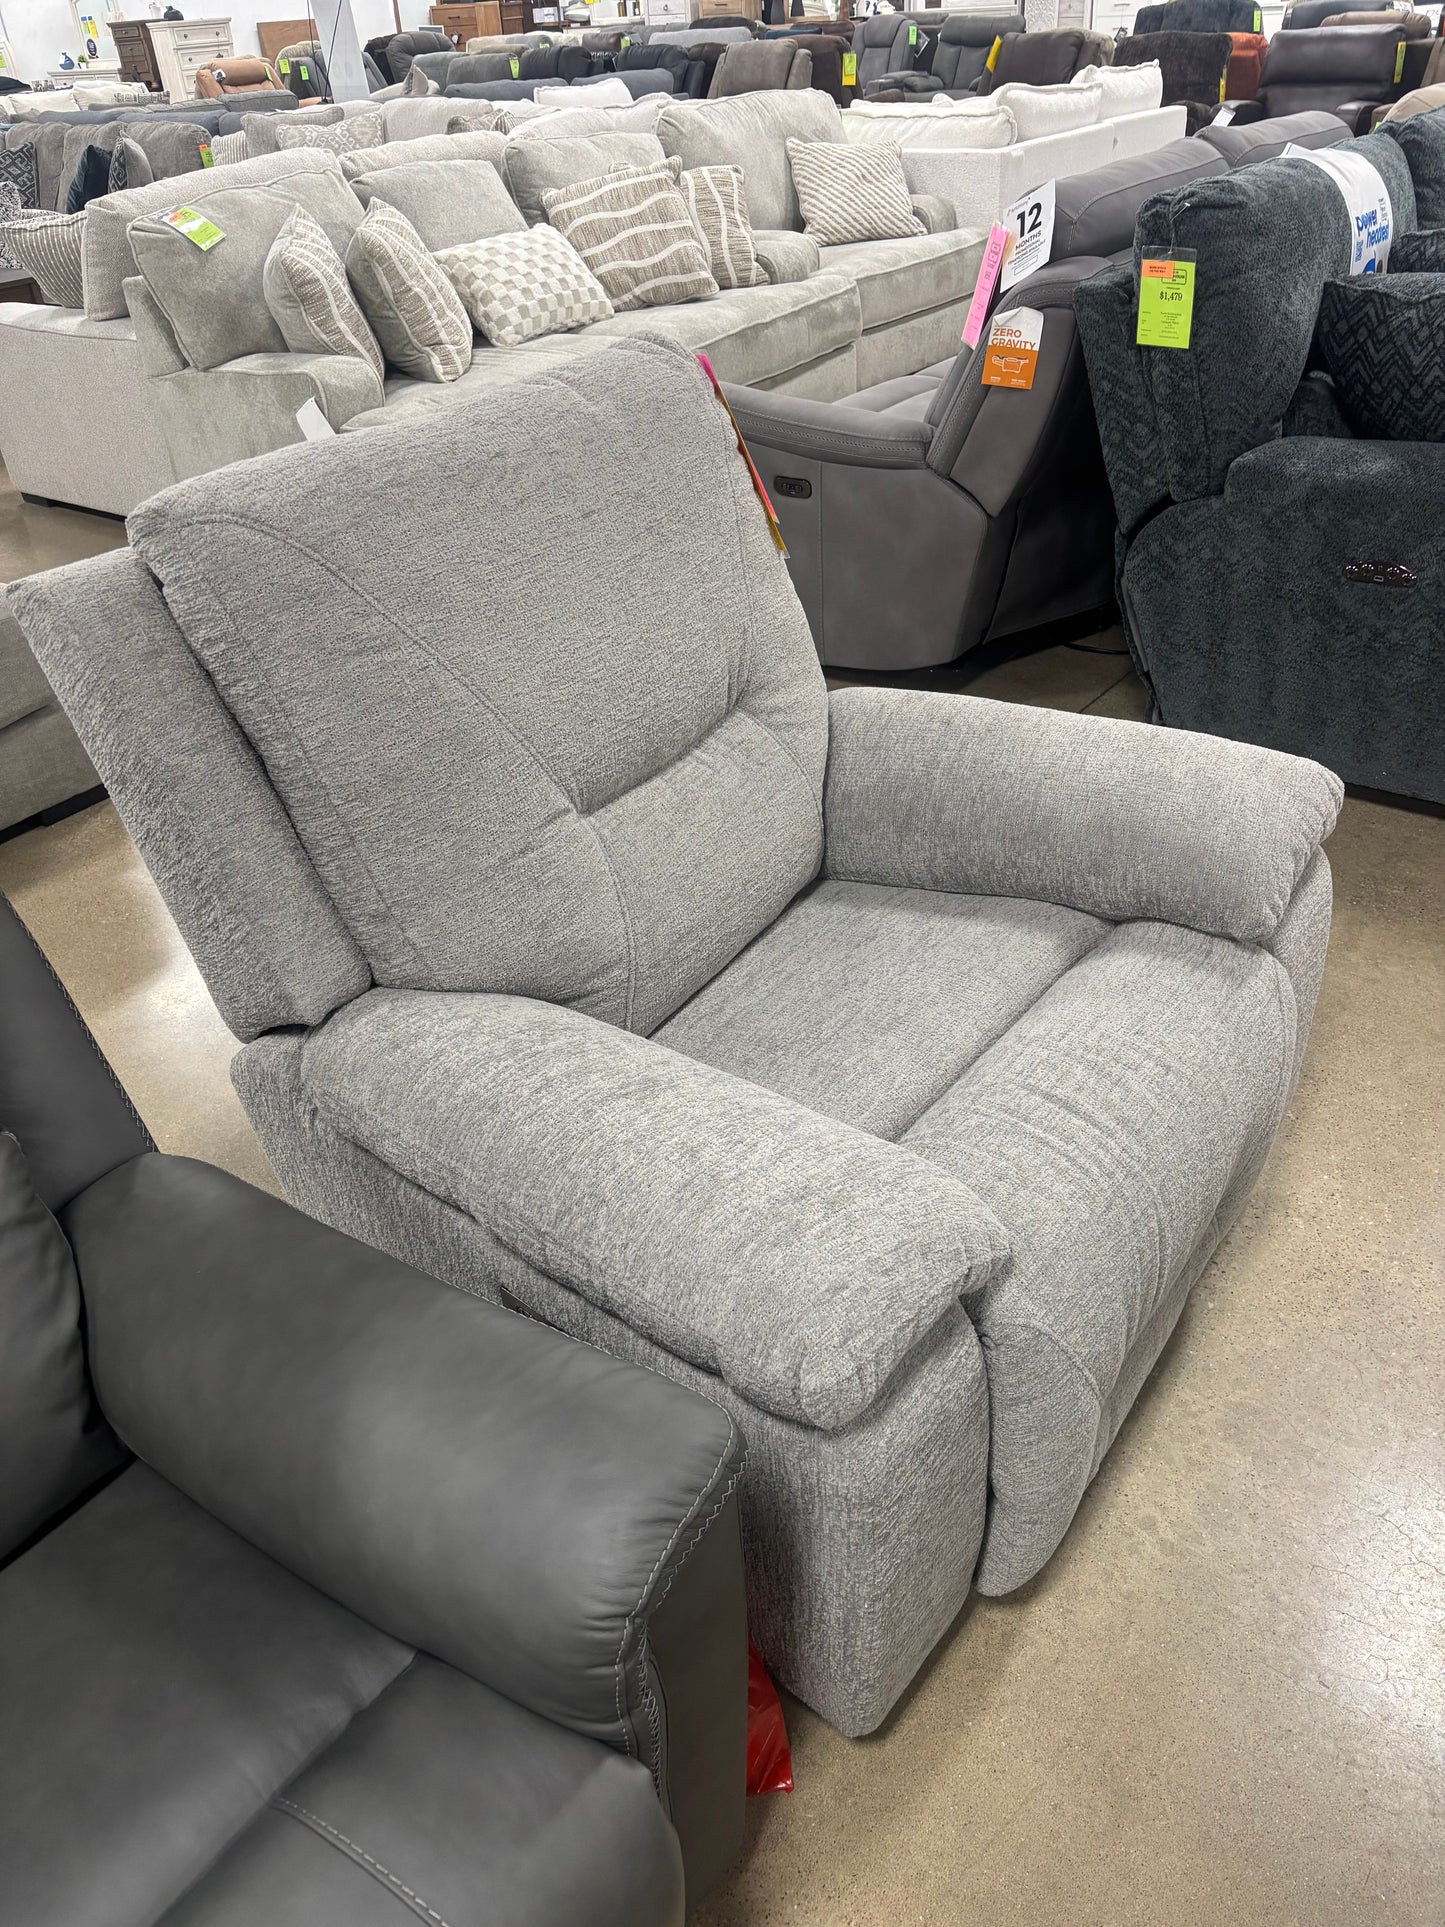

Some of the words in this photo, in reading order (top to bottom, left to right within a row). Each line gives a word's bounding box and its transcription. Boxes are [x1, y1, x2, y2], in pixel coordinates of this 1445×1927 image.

[1016, 201, 1042, 238] 12
[1015, 230, 1042, 251] MONTHS
[1159, 291, 1183, 301] $1,479
[992, 327, 1022, 338] ZERO
[991, 337, 1037, 350] GRAVITY
